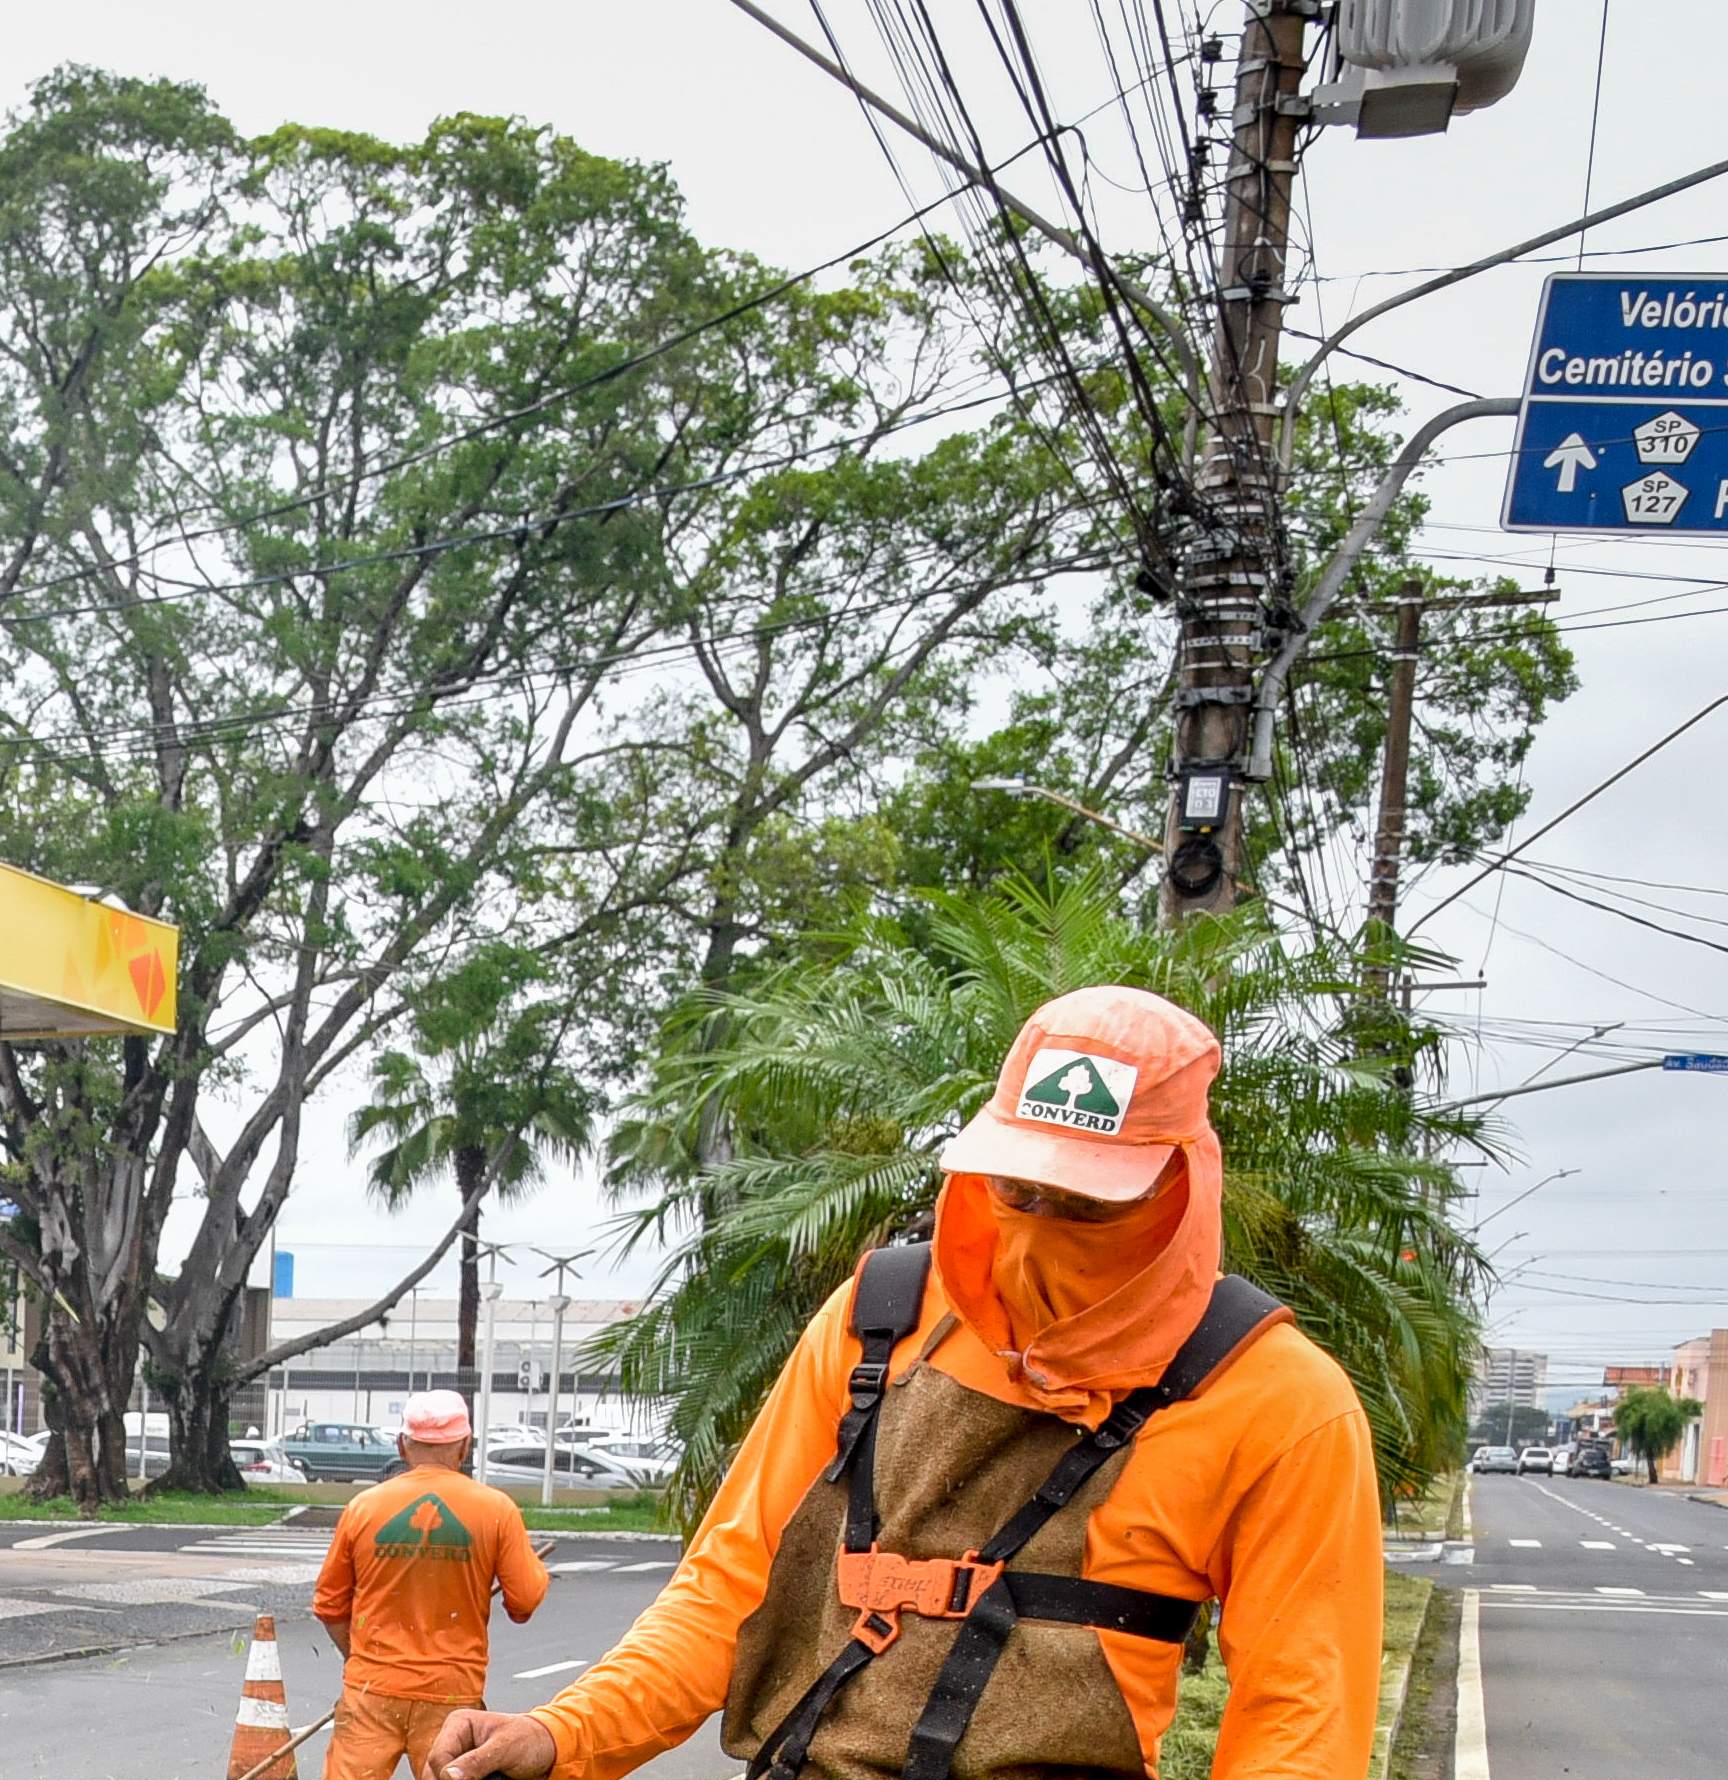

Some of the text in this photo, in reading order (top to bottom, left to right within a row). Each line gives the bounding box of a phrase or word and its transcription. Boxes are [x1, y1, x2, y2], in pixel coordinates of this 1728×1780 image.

[1620, 291, 1728, 328] Velóri
[1539, 348, 1713, 387] Cemitério
[1654, 420, 1682, 433] SP
[1641, 436, 1689, 453] 310
[1642, 480, 1670, 493] SP
[1631, 495, 1677, 513] 127
[1021, 1102, 1116, 1132] CONVERD
